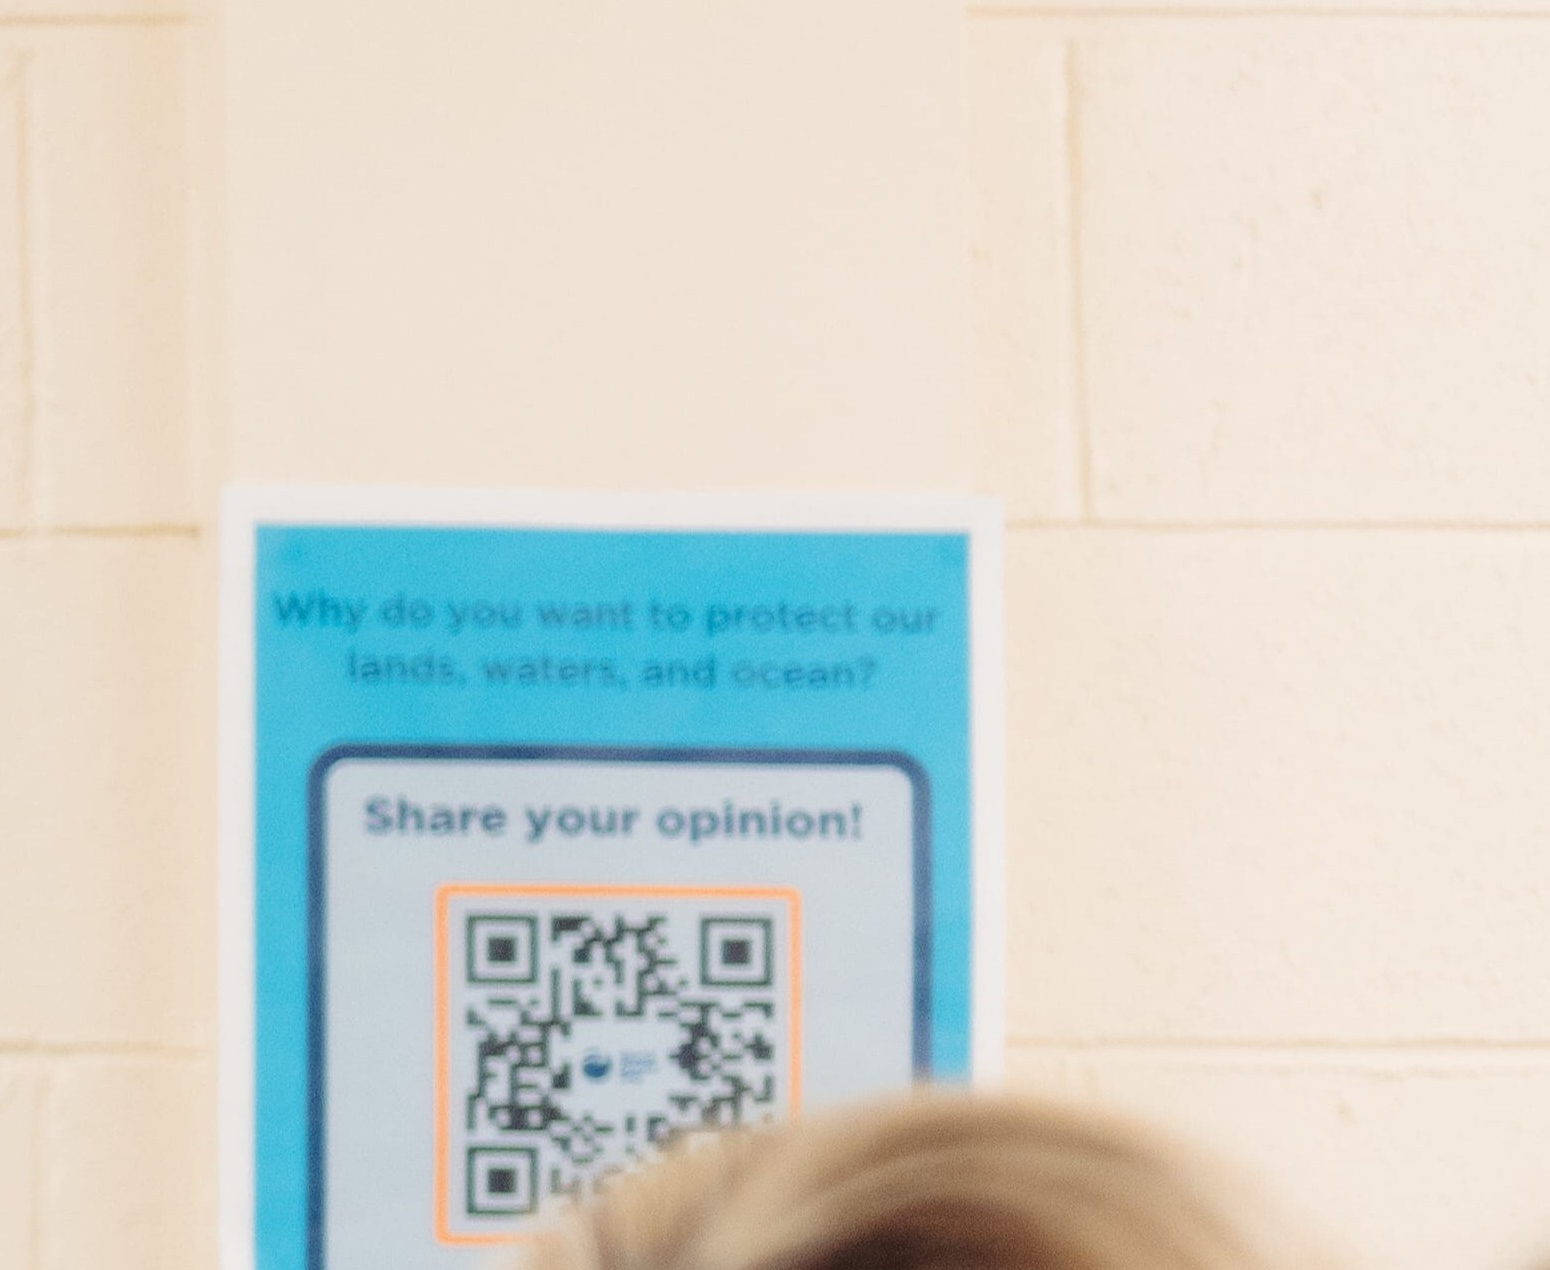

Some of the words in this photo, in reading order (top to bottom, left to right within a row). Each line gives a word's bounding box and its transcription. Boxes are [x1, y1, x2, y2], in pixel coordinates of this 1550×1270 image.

[272, 592, 363, 634] Why
[382, 593, 432, 629] do
[448, 602, 521, 634] you
[536, 599, 633, 631] want
[646, 601, 691, 632] to
[706, 600, 859, 637] protect
[871, 606, 943, 635] our
[347, 652, 466, 689] lands,
[480, 656, 628, 690] waters,
[643, 656, 717, 691] and
[730, 656, 878, 692] ocean?
[364, 796, 507, 838] Share
[525, 803, 641, 842] your
[656, 803, 864, 844] opinion!
